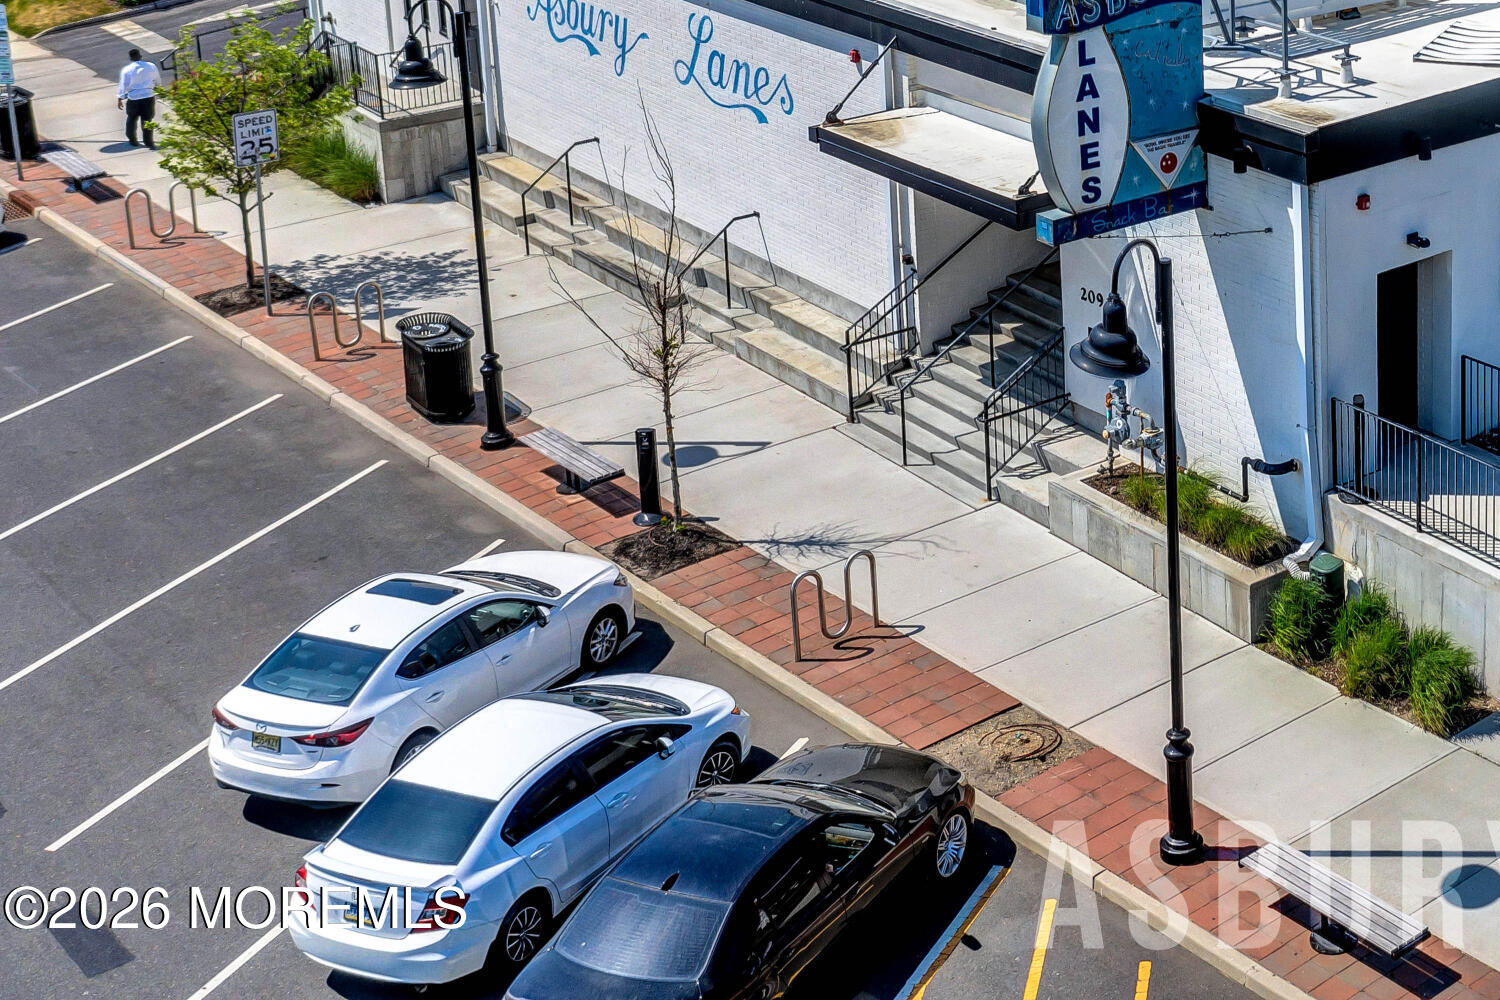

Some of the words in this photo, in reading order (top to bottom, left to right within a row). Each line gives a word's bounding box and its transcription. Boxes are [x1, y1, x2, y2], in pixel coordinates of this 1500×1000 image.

[673, 12, 795, 125] Lanes
[237, 115, 273, 129] SPEED
[1075, 39, 1102, 205] LANES
[240, 136, 274, 160] 25
[1091, 203, 1136, 233] Snack
[1080, 286, 1104, 308] 209
